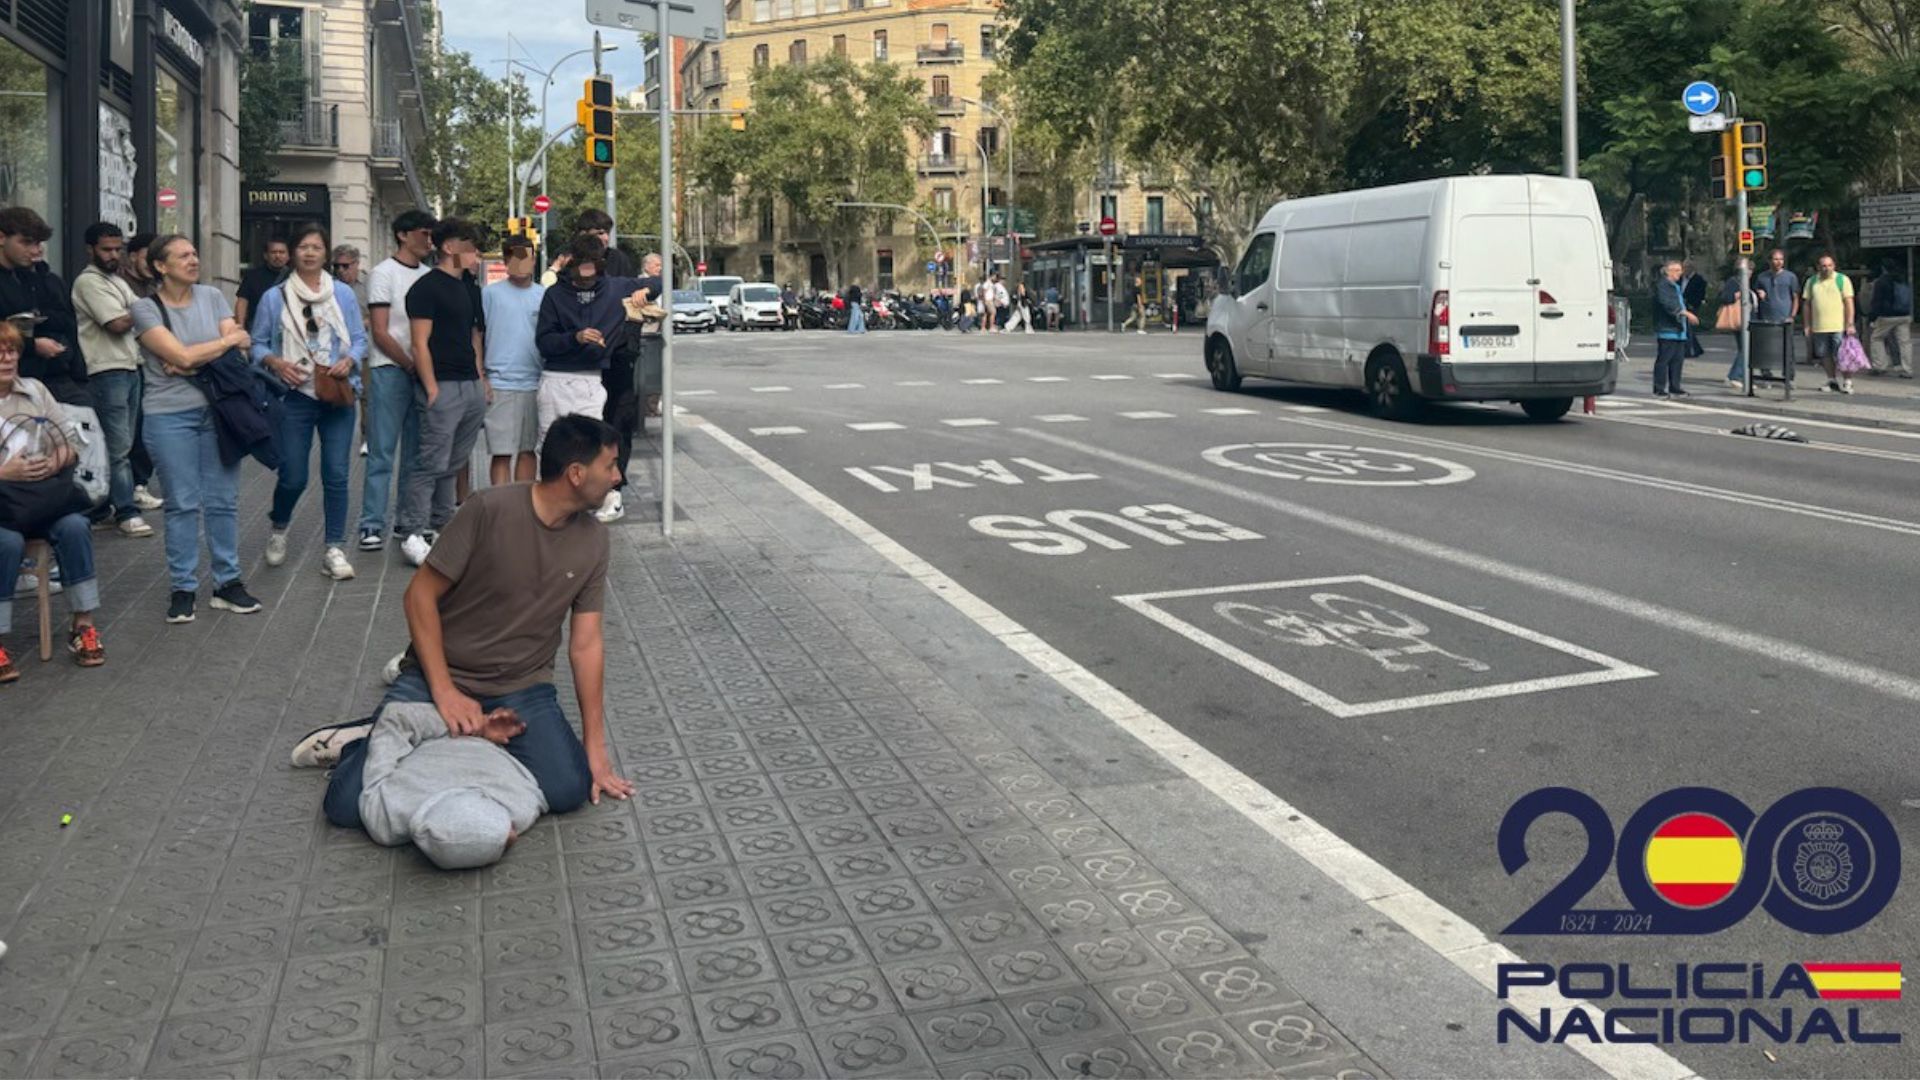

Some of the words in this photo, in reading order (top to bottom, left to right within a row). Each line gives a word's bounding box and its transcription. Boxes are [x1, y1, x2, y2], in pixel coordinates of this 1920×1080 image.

[248, 190, 307, 206] pannus
[843, 457, 1102, 493] TAXI
[968, 503, 1267, 556] BUS
